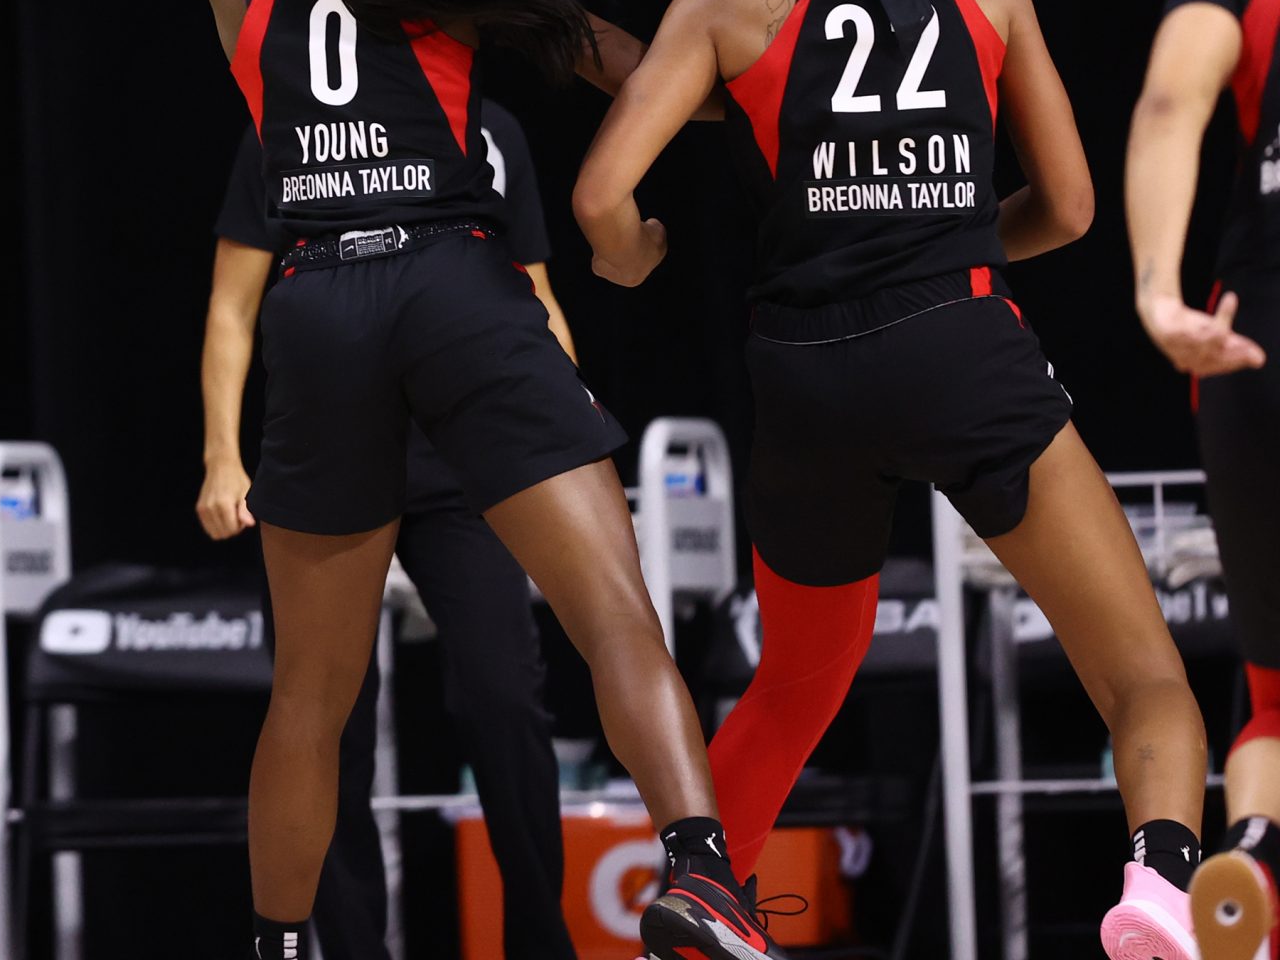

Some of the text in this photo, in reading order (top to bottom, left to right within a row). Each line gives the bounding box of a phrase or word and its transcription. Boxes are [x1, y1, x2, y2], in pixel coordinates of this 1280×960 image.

[824, 3, 947, 113] 22
[294, 121, 389, 164] YOUNG
[812, 134, 971, 180] WILSON
[282, 165, 432, 203] BREONNA TAYLOR
[807, 181, 976, 212] BREONNA TAYLOR
[115, 611, 246, 651] YouTube
